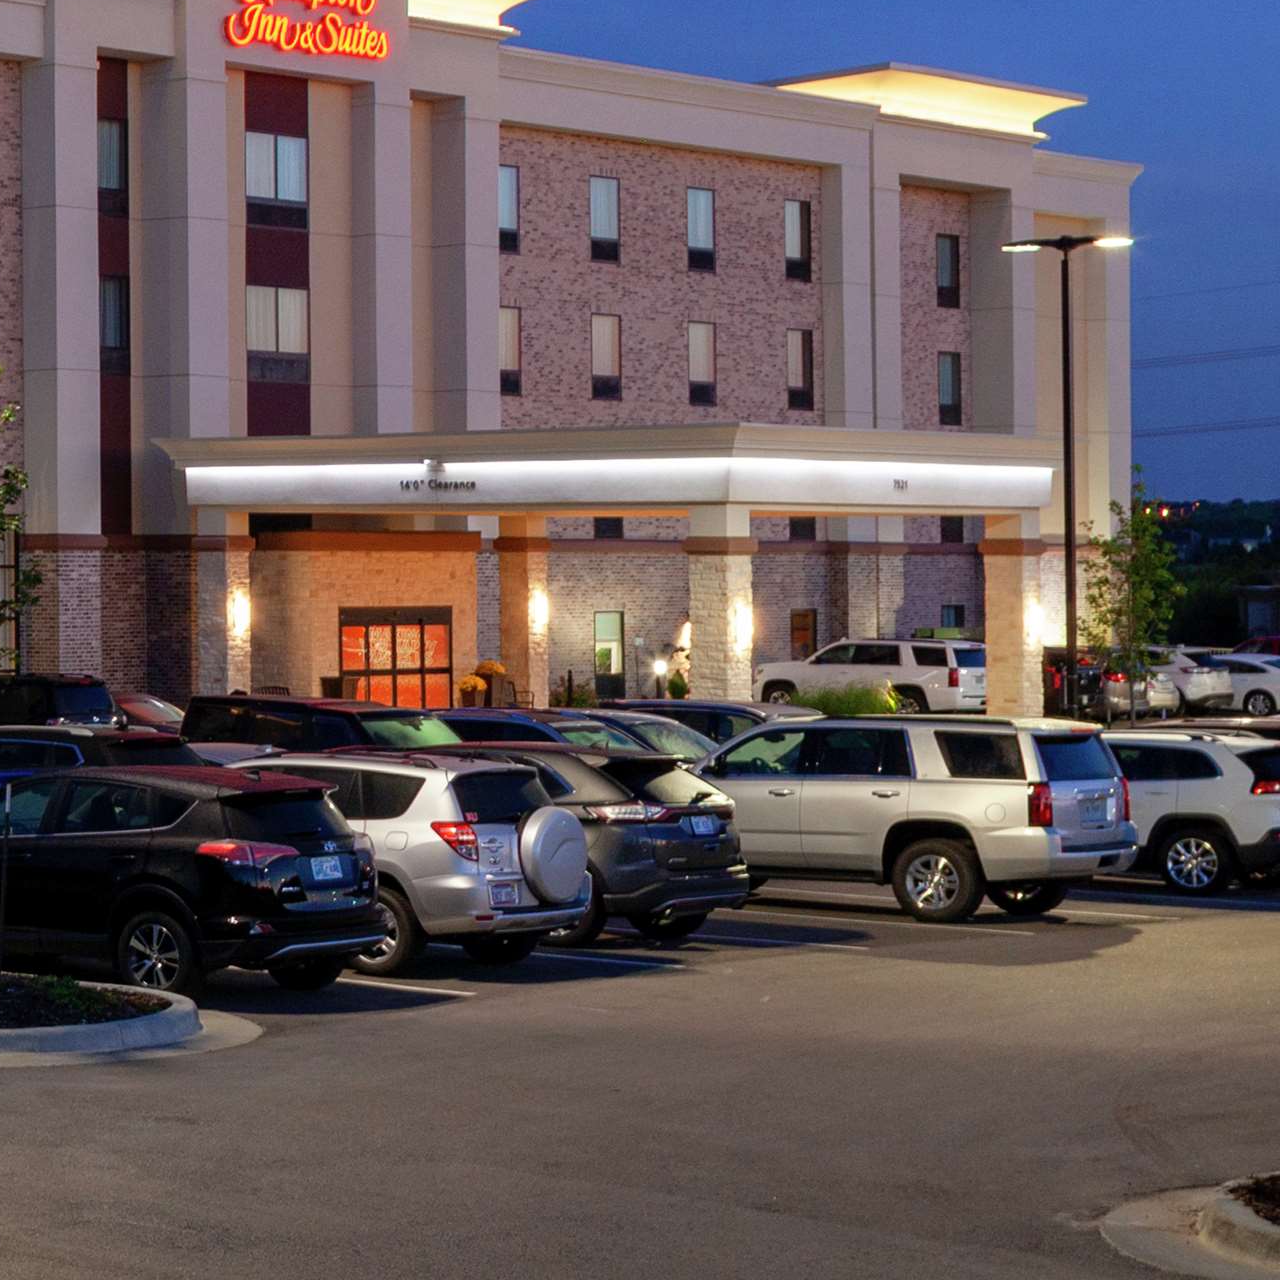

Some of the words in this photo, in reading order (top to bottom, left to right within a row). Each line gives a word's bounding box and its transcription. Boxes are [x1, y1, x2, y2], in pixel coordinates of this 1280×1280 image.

[225, 4, 301, 51] Inn
[300, 21, 318, 54] &
[316, 12, 389, 61] Suites
[428, 479, 476, 490] Clearance
